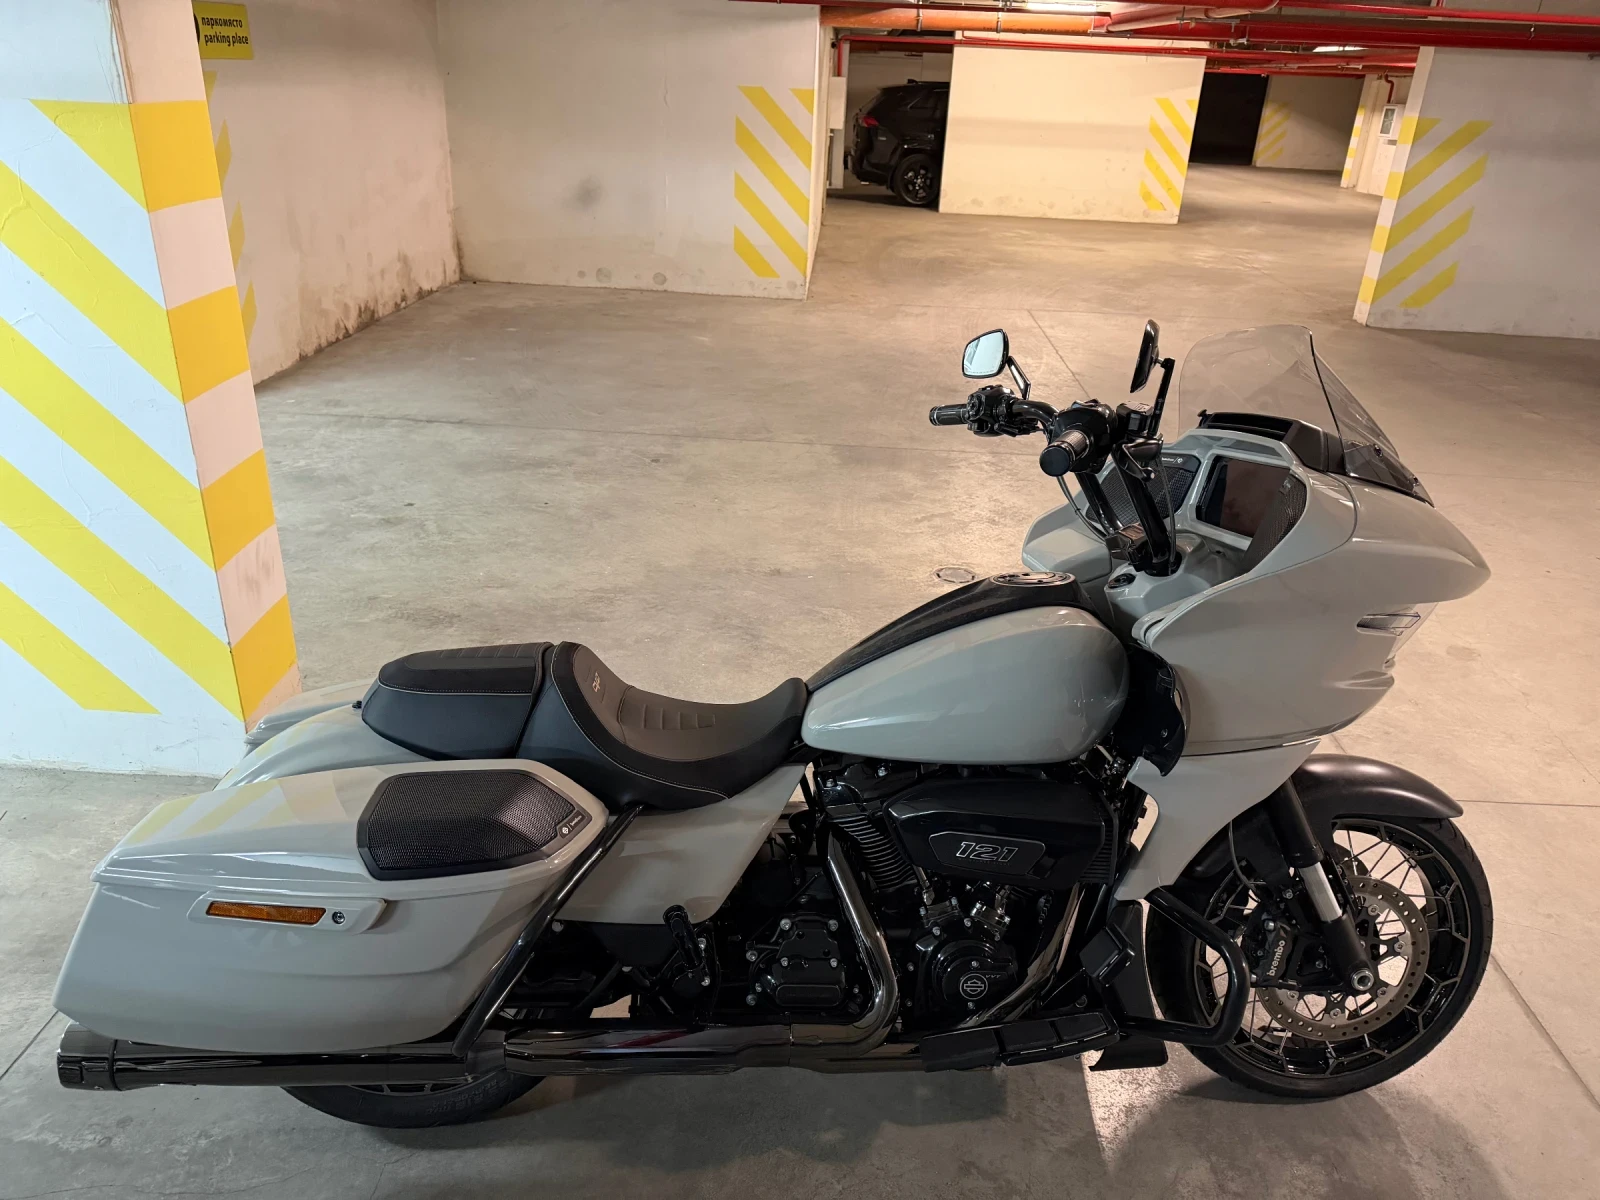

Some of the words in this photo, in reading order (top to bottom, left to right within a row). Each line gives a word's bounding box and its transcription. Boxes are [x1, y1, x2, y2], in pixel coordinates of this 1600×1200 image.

[201, 17, 243, 29] паркомясто
[204, 31, 231, 47] parking
[231, 32, 249, 47] place
[956, 841, 1019, 862] 121
[1266, 940, 1286, 977] brembo
